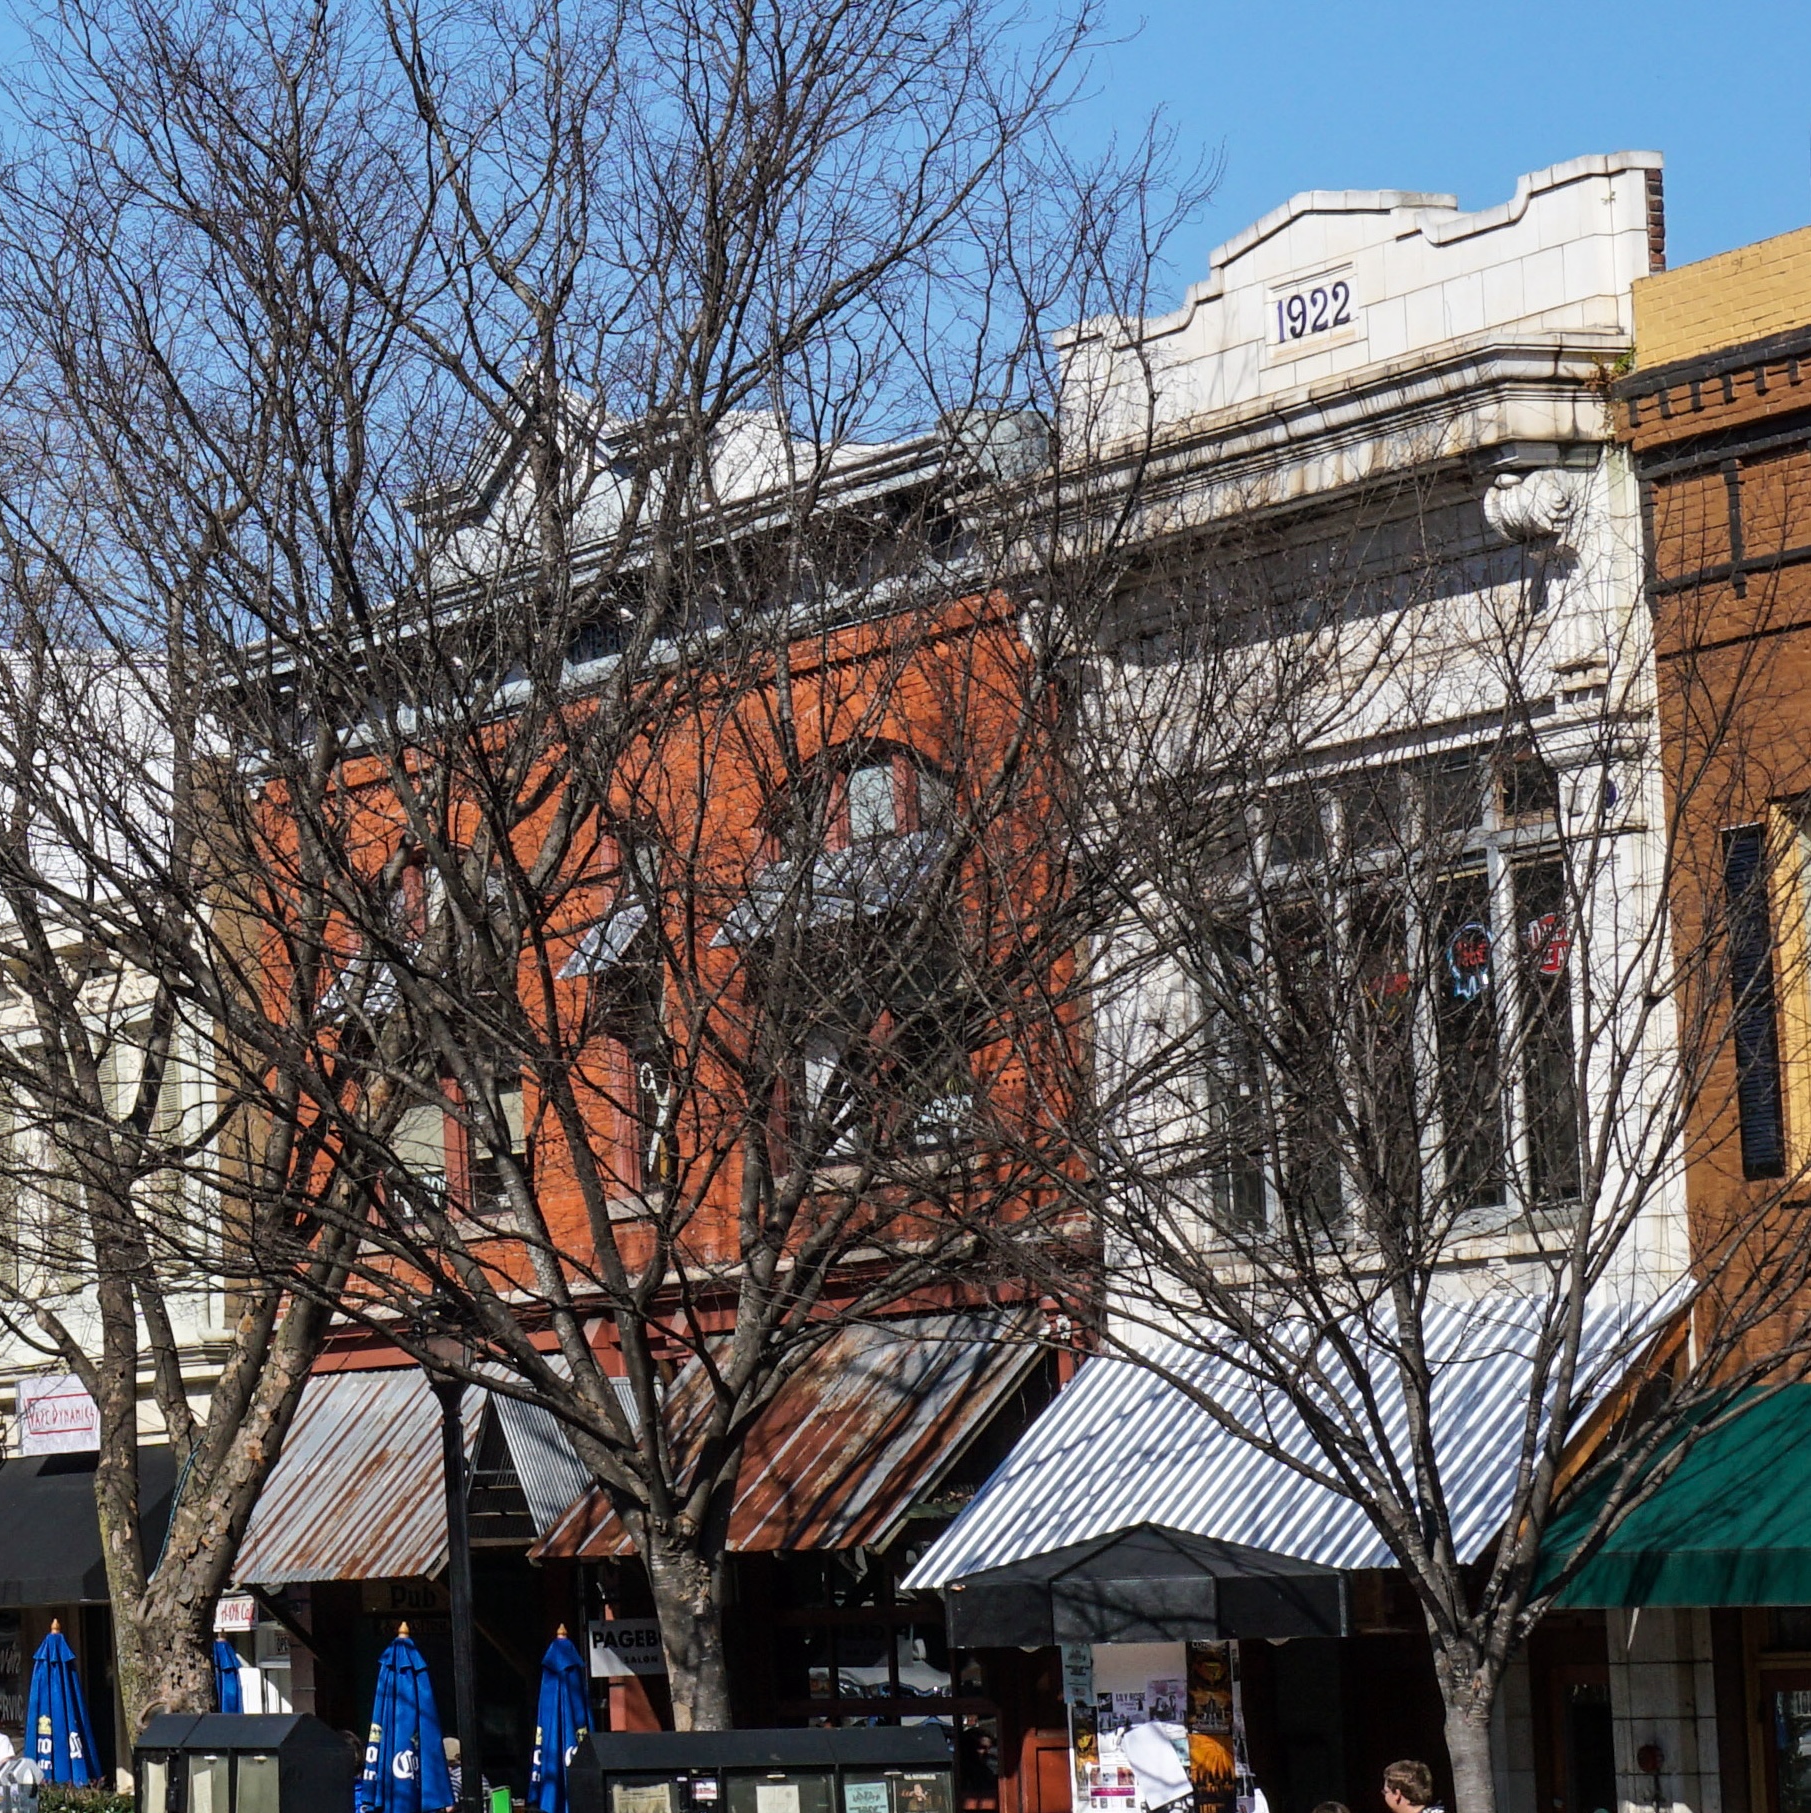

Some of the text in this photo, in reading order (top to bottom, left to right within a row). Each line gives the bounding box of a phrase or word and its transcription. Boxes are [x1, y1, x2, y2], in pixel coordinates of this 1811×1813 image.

[1277, 281, 1350, 343] 1922
[391, 1585, 437, 1608] Pub
[624, 1655, 658, 1664] SALON
